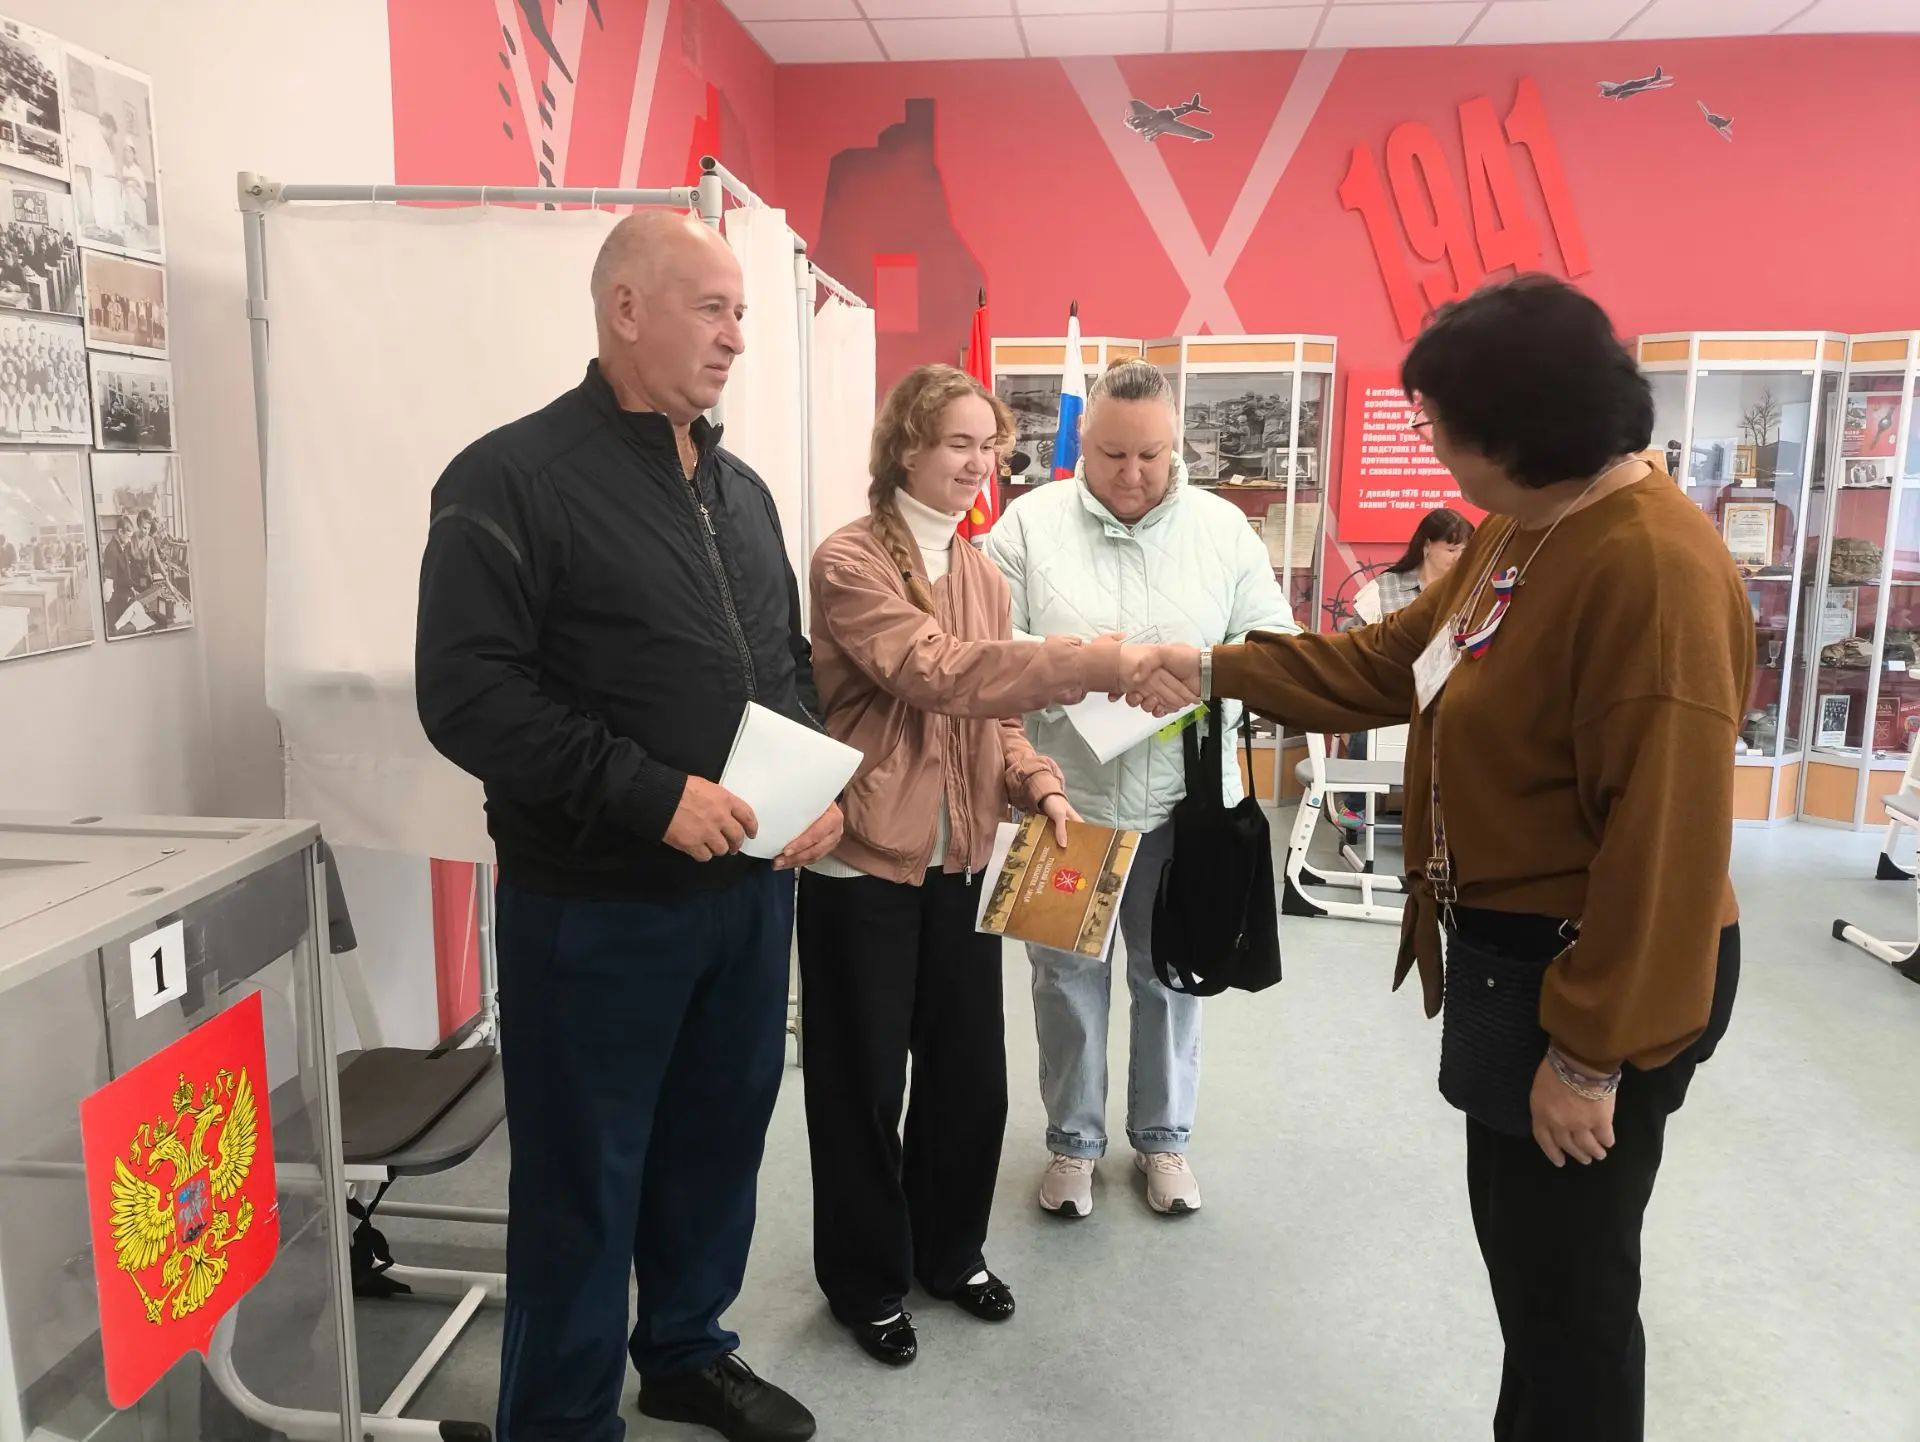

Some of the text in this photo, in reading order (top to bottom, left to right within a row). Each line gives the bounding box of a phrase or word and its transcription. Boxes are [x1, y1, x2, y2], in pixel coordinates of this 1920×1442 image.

[1337, 74, 1593, 342] 1941
[1366, 489, 1401, 499] декабря
[150, 946, 170, 996] 1
